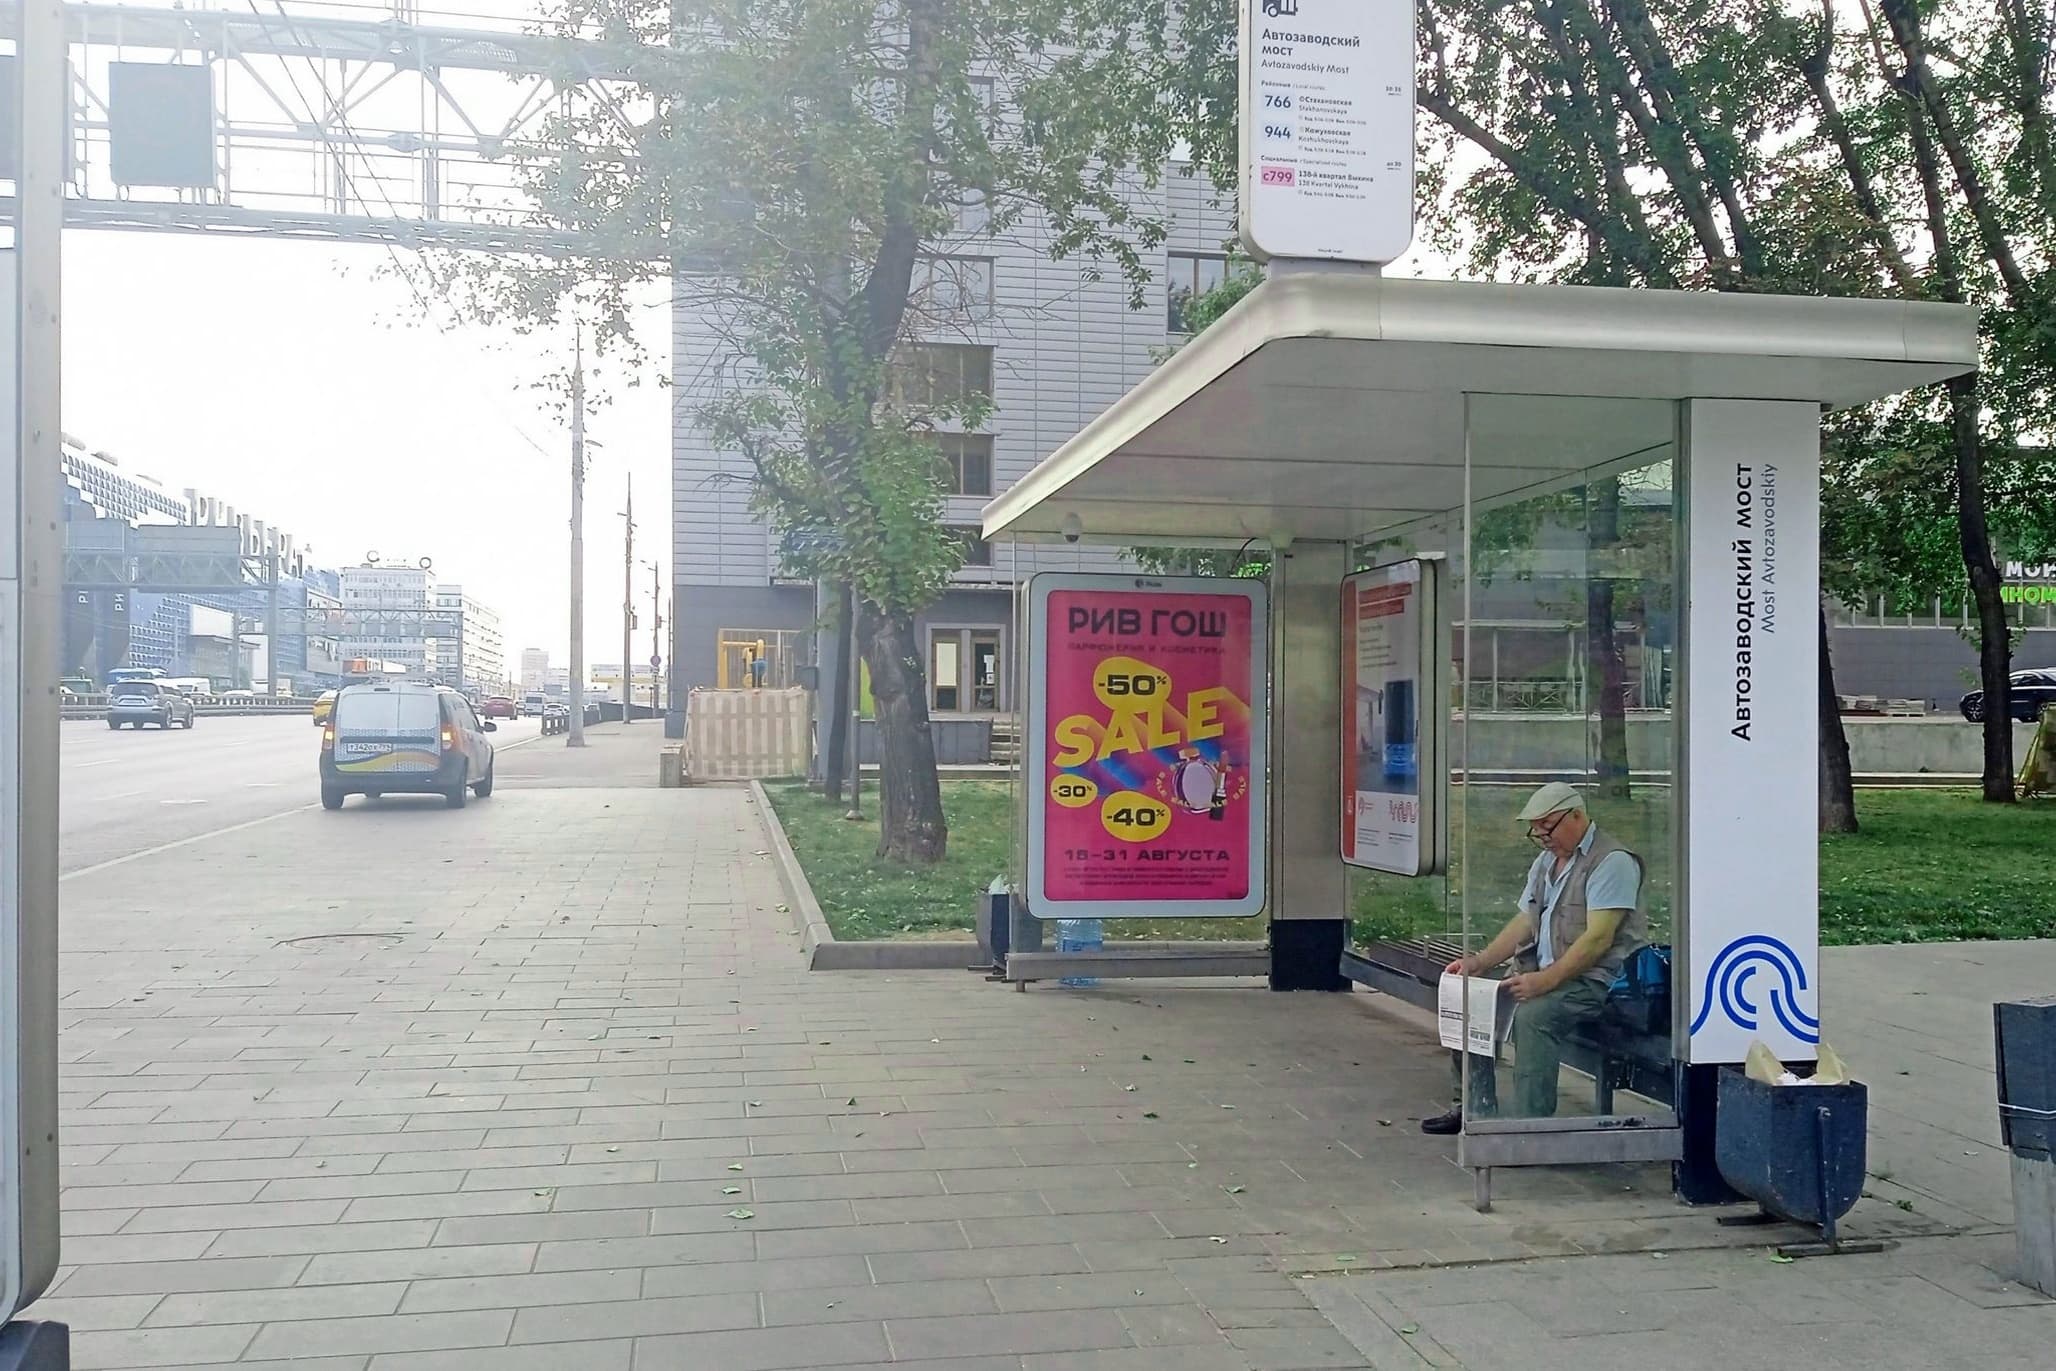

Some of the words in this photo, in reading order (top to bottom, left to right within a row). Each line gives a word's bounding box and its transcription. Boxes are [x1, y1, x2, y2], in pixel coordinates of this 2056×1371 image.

[1262, 28, 1360, 47] Автозаводский
[1262, 45, 1293, 56] мост
[1261, 59, 1325, 73] Avtozavodskiy
[1326, 64, 1350, 74] Most
[1264, 95, 1291, 108] 766
[1264, 125, 1291, 139] 944
[1263, 170, 1293, 183] с799
[1736, 463, 1753, 529] мост
[1760, 463, 1778, 584] Avtozavodskiy
[1760, 590, 1776, 634] Most
[1068, 607, 1141, 635] РИВ
[1151, 609, 1227, 638] ГОШ
[1731, 538, 1754, 741] Автозаводский
[1098, 674, 1168, 696] -50%
[1052, 686, 1226, 768] SALE
[1053, 785, 1093, 798] -30%
[1106, 807, 1166, 827] -40%
[1138, 849, 1230, 861] АВГУСТА
